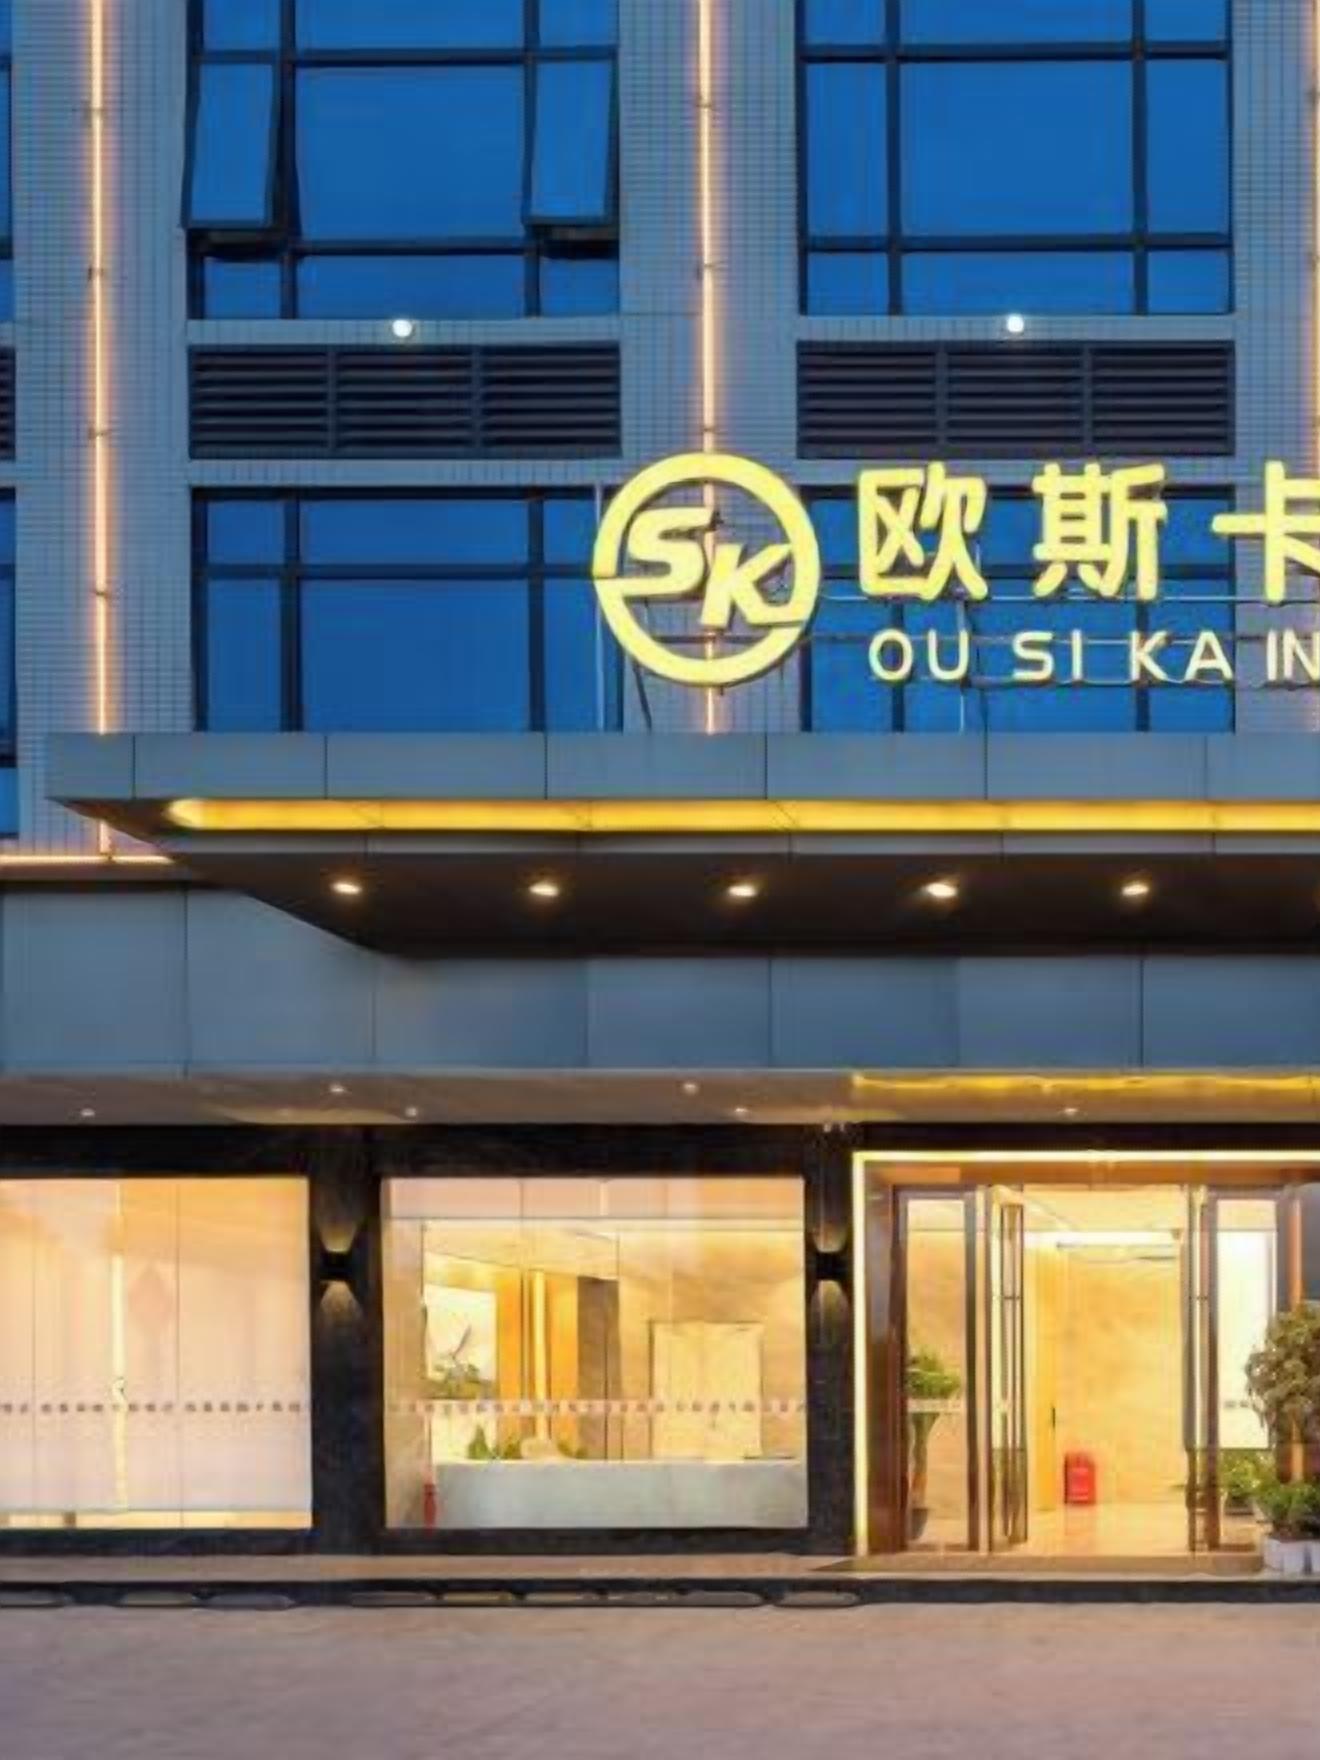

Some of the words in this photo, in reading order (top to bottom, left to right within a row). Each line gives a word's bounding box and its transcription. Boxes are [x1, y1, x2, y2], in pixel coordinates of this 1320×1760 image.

[867, 630, 970, 682] OU
[1011, 630, 1083, 682] SI
[1128, 630, 1234, 682] KA
